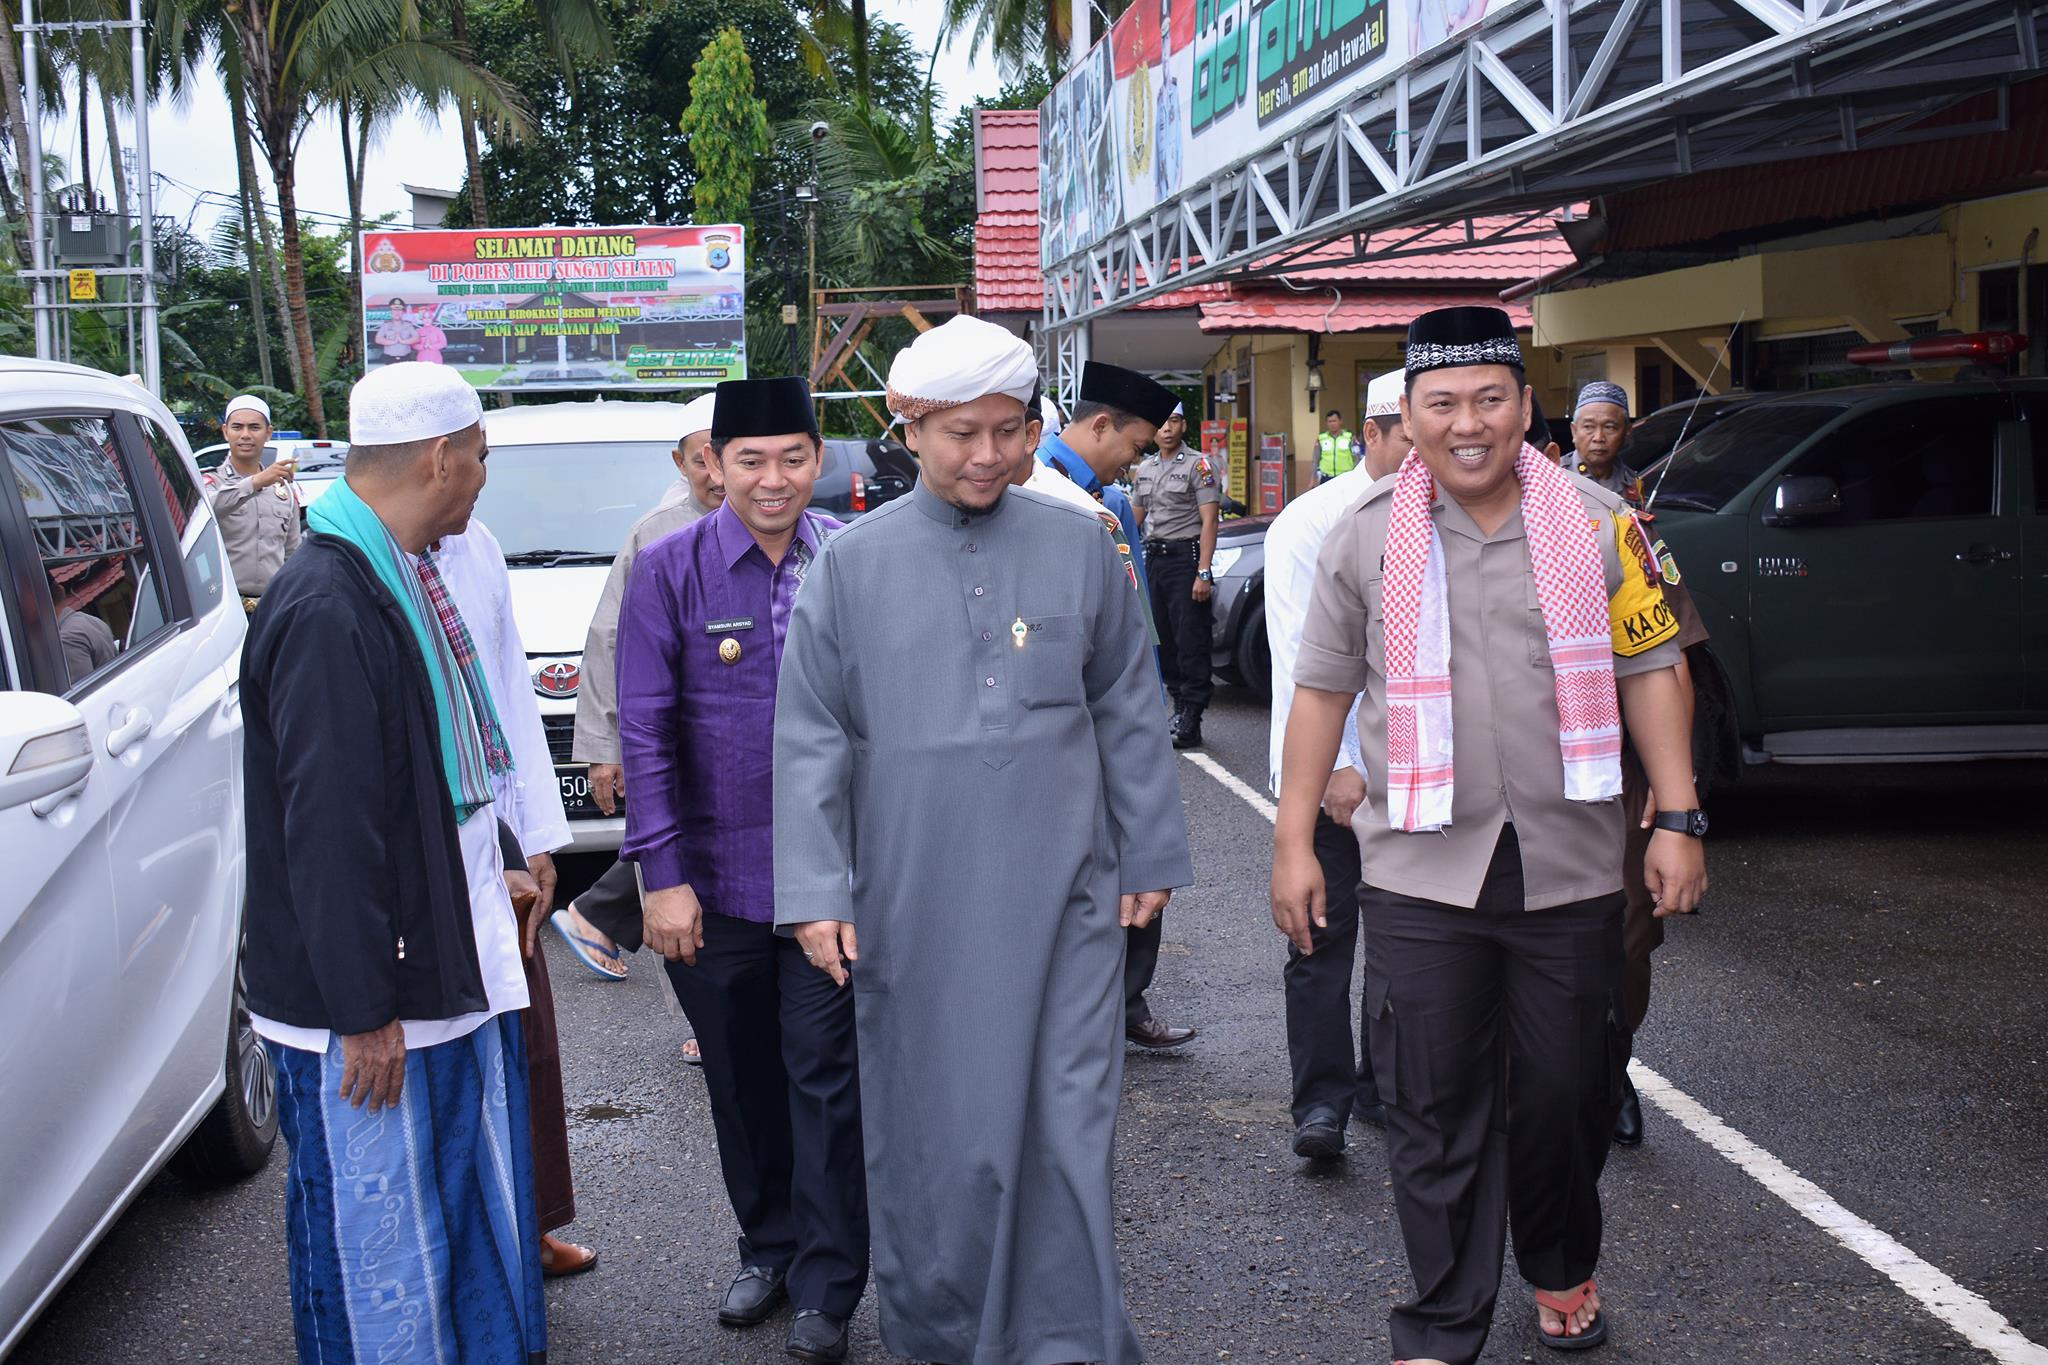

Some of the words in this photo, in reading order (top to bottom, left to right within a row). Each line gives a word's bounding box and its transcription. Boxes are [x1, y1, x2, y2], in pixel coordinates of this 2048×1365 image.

[1258, 77, 1292, 119] bersih,
[1292, 61, 1320, 98] aman
[1321, 49, 1339, 80] dan
[1340, 9, 1385, 68] tawakal
[475, 237, 556, 259] SELAMAT
[561, 235, 636, 257] DATANG
[430, 263, 449, 281] DI
[451, 263, 510, 281] POLRES
[513, 262, 552, 280] HULU
[555, 260, 610, 279] SUNGAI
[612, 259, 675, 278] SELATAN
[543, 296, 563, 306] DAN
[467, 309, 507, 320] WILAYAH
[509, 308, 559, 319] BIROKRASI
[562, 307, 595, 318] BERSIH
[597, 307, 640, 317] MELAYANI
[484, 324, 512, 337] KAMI
[514, 323, 538, 336] SIAP
[541, 323, 590, 336] MELAYANI
[592, 322, 621, 335] ANDA
[626, 345, 738, 367] Beramal
[1623, 611, 1654, 643] KA
[1653, 599, 1673, 627] OP
